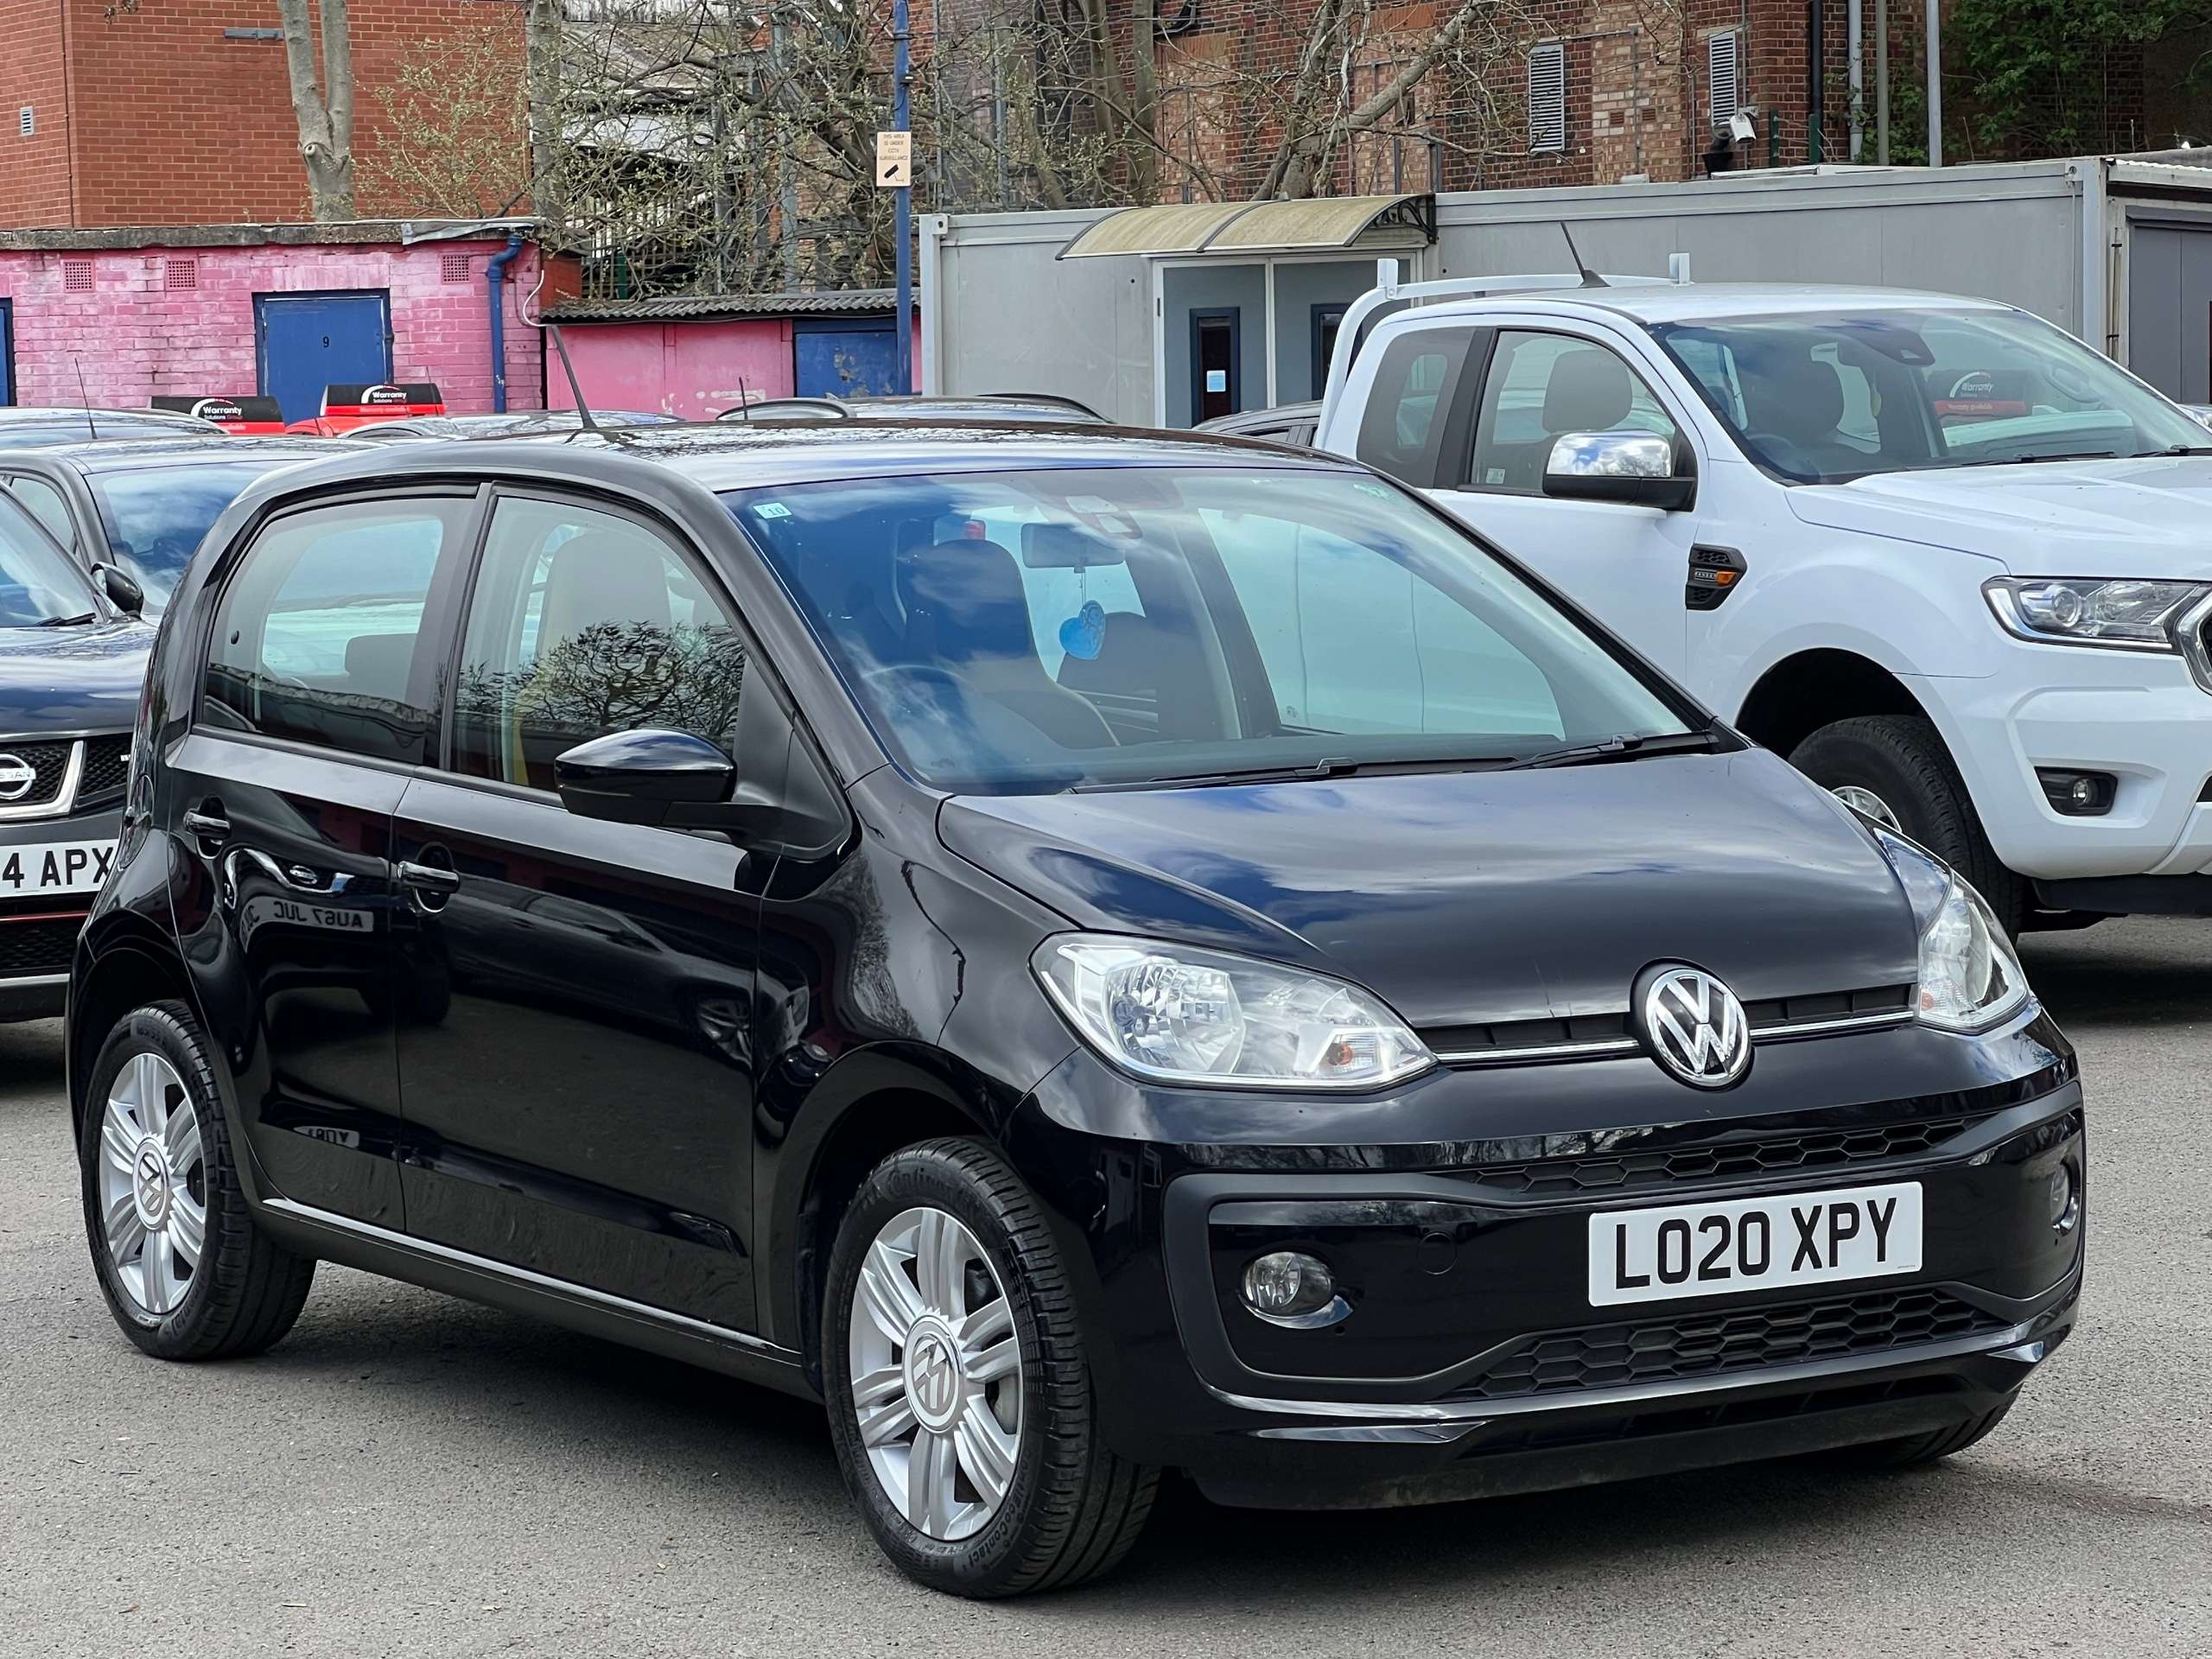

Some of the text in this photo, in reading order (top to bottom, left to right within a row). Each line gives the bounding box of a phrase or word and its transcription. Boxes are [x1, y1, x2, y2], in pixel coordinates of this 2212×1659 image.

[322, 336, 329, 347] 9
[1961, 382, 1994, 394] Warranty
[372, 391, 407, 401] Warranty
[203, 406, 242, 416] Warranty
[3, 847, 113, 888] 4 APX
[1616, 1198, 1897, 1289] LO20 XPY
